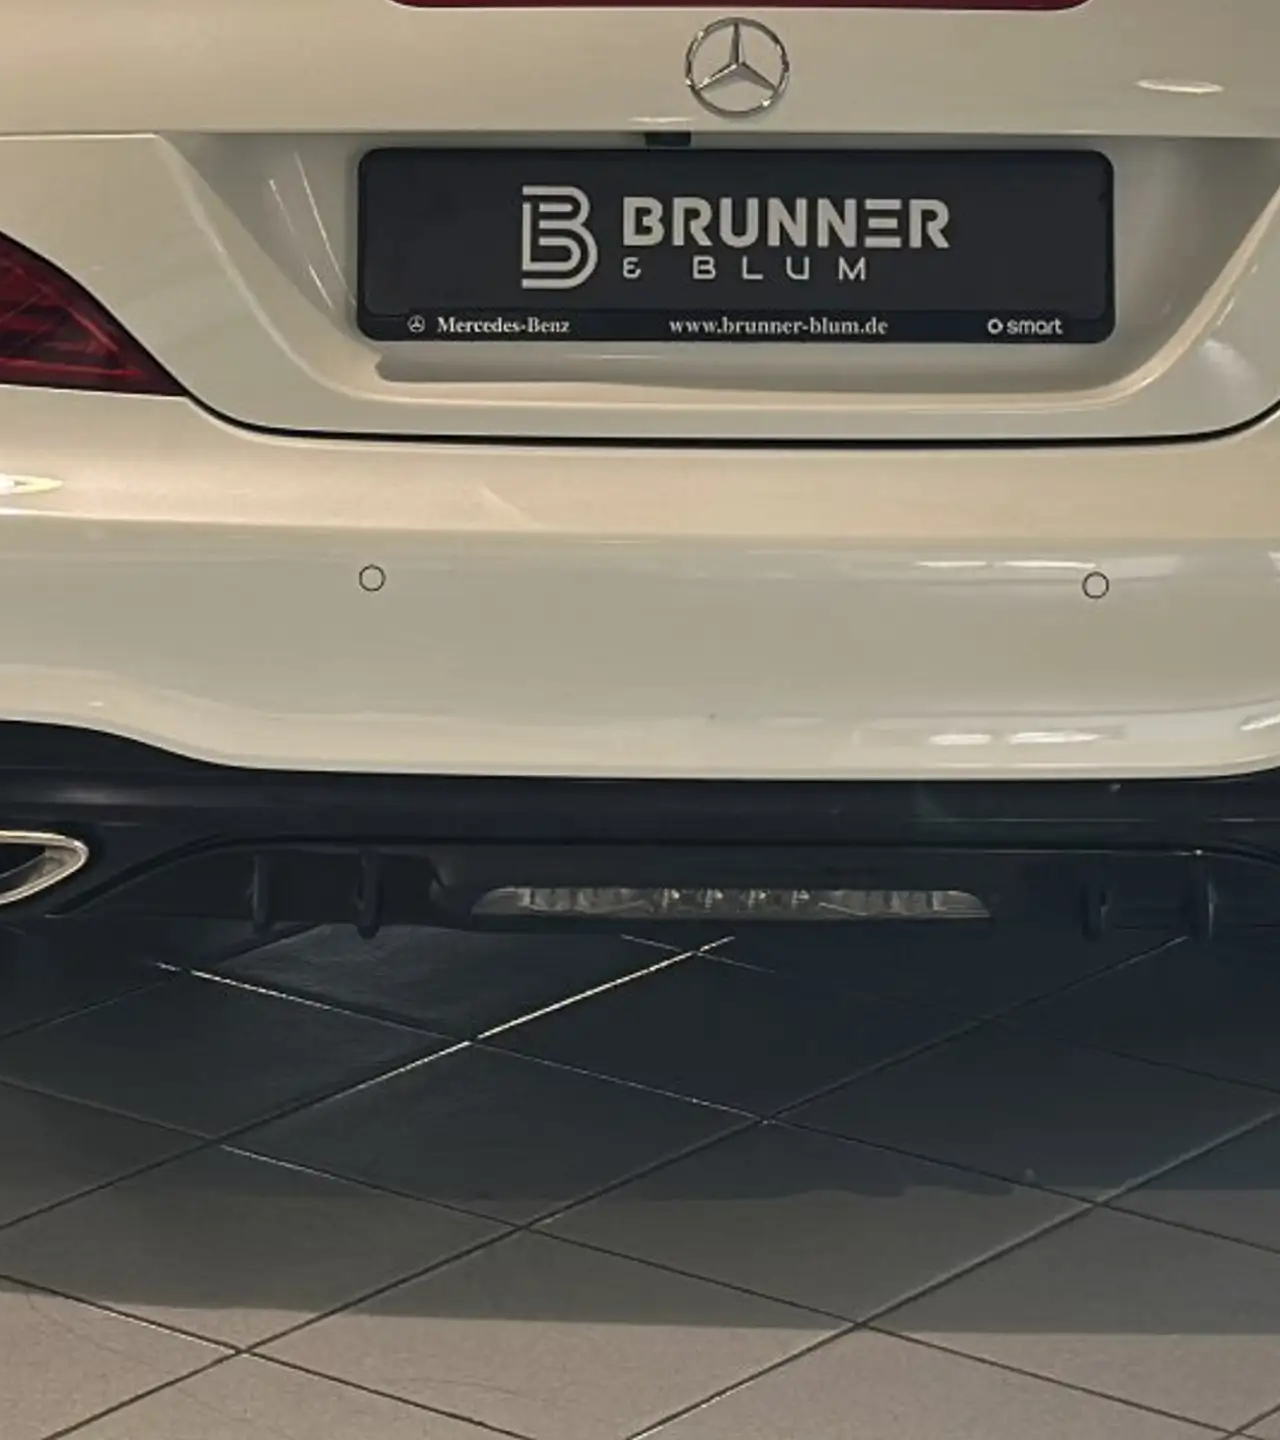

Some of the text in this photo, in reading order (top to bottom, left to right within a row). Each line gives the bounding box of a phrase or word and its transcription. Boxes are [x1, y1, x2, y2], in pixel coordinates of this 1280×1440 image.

[622, 196, 951, 250] BRUNNER
[691, 254, 868, 282] BLUM
[436, 316, 571, 335] Mercedes-Benz
[668, 316, 890, 336] www.brunner-blum.de
[1005, 318, 1064, 336] smart
